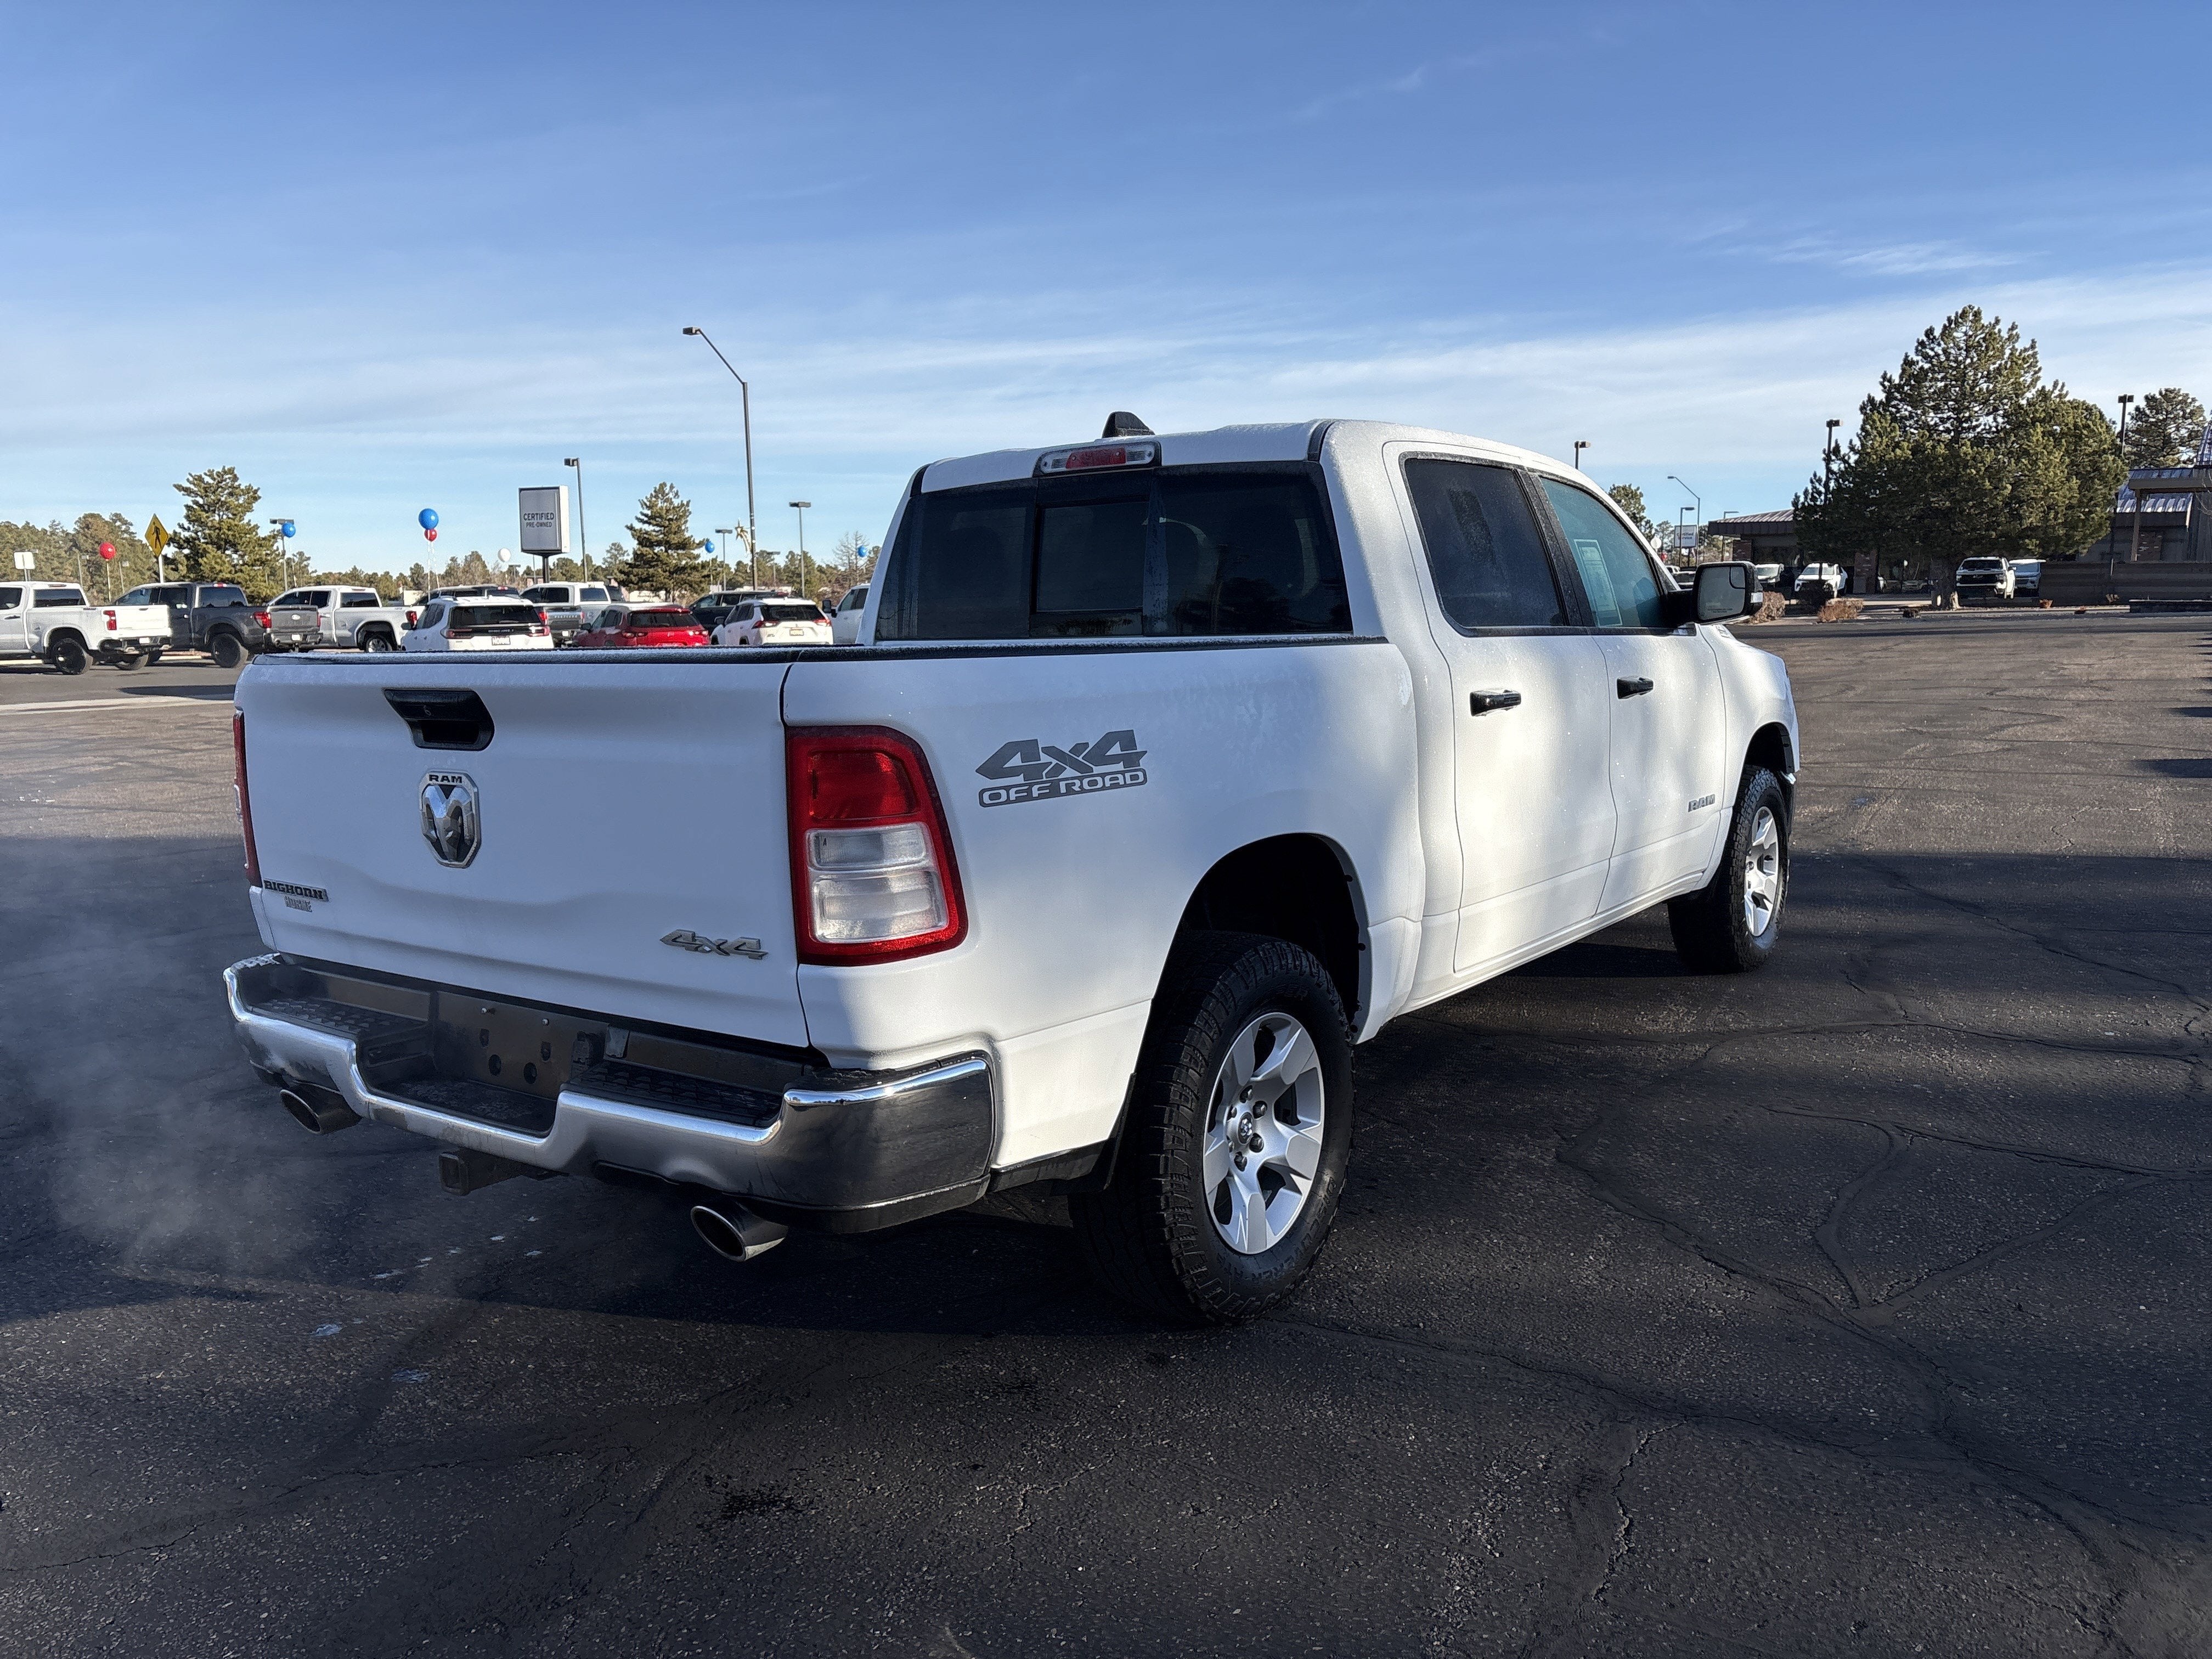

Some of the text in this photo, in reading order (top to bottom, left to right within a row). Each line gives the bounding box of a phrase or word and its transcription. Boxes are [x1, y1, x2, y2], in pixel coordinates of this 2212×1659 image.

[523, 512, 555, 521] CERTIFIED
[428, 774, 462, 783] RAM
[982, 771, 1145, 805] OFF ROAD
[1688, 793, 1716, 812] RAM
[263, 879, 324, 900] BIGHORN
